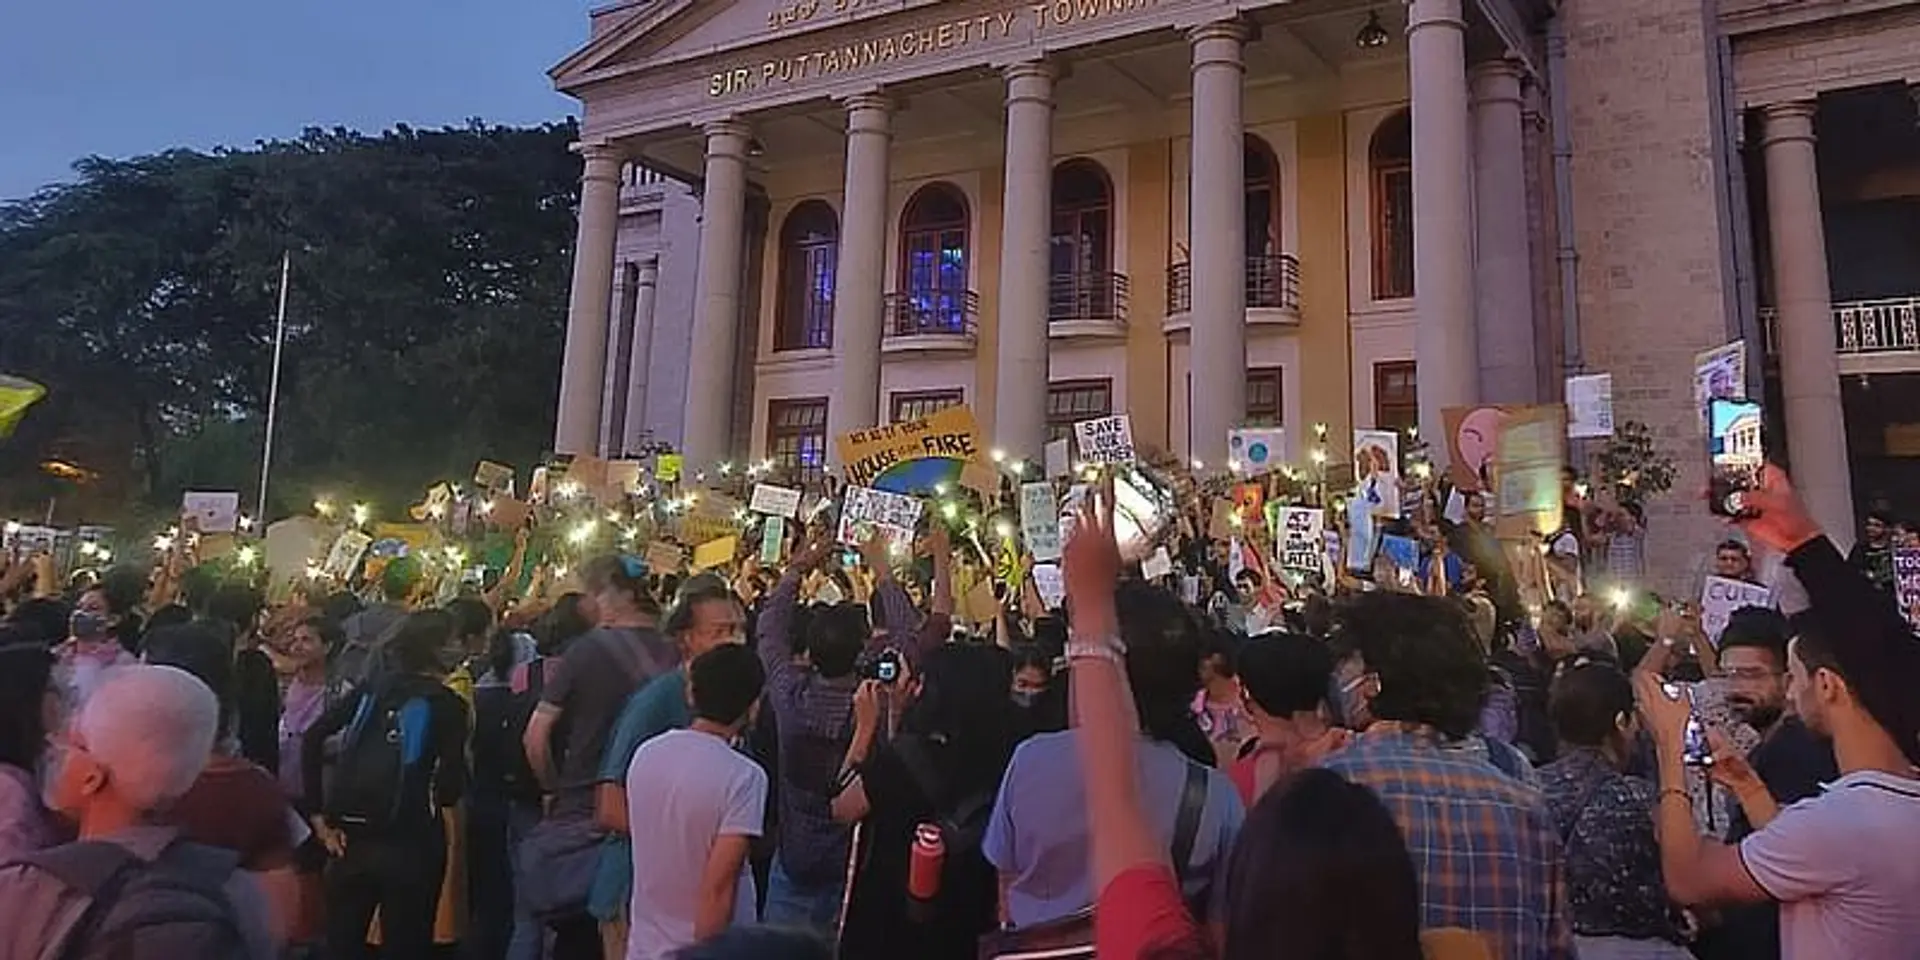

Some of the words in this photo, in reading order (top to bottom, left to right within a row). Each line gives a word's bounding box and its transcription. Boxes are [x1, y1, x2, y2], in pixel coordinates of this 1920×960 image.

[763, 11, 1016, 86] PUTTANNACHETTY
[1085, 418, 1122, 435] SAVE
[1096, 433, 1119, 449] OUR
[851, 448, 899, 488] HOUSE
[922, 433, 977, 458] FIRE
[1288, 511, 1310, 522] ACT
